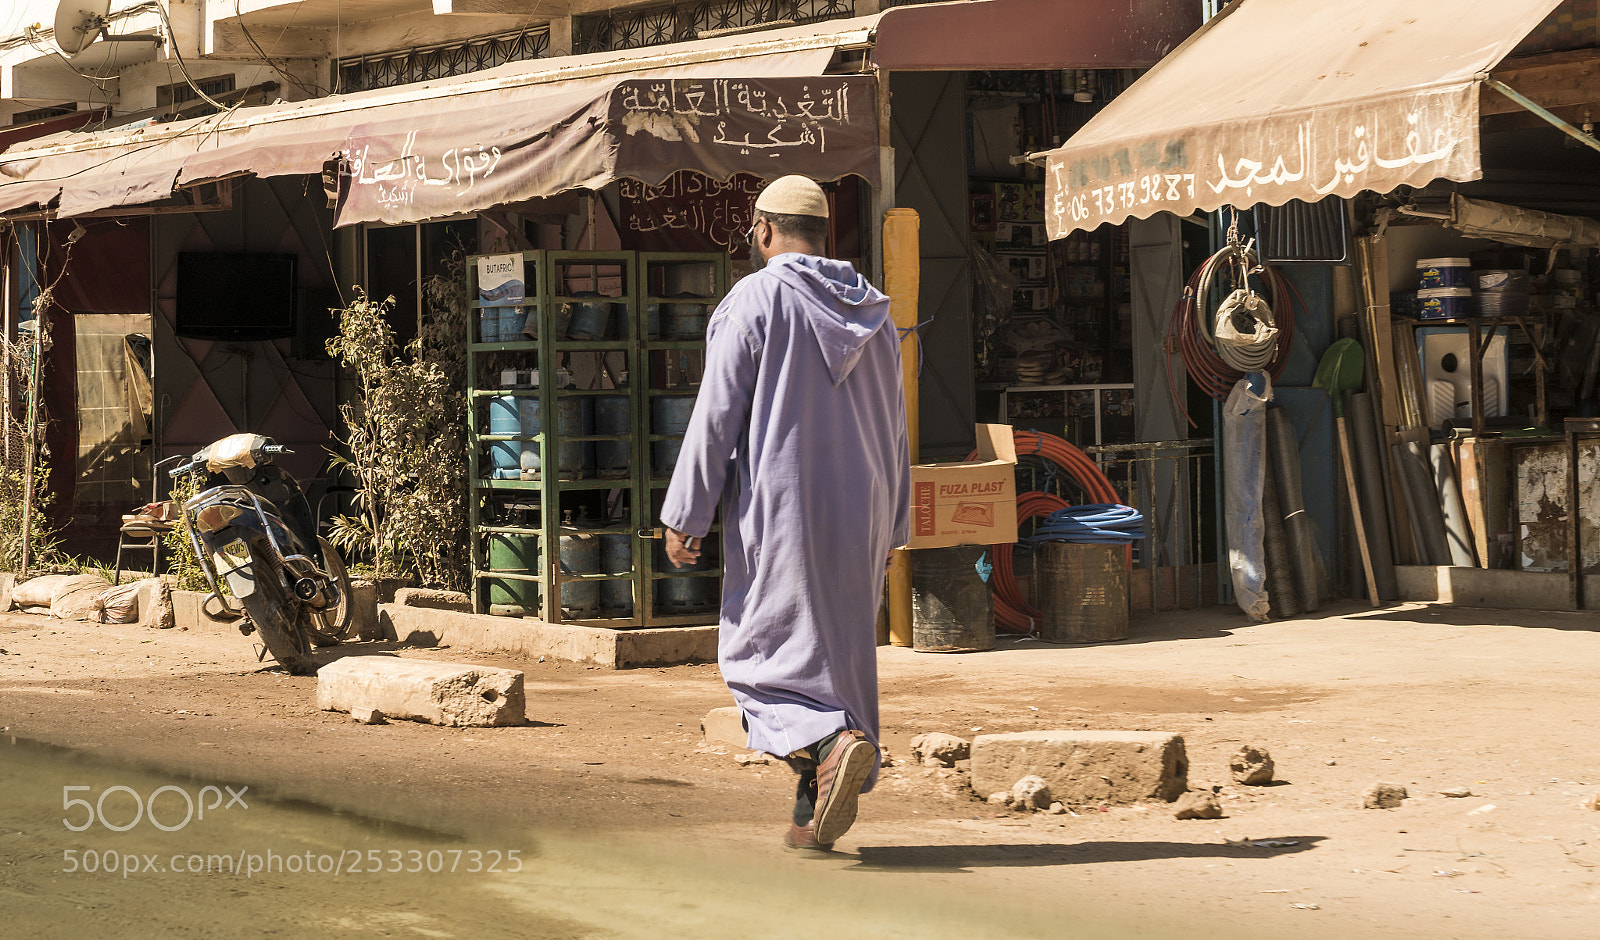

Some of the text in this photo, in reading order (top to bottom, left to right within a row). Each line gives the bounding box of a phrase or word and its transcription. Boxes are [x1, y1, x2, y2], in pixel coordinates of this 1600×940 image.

[1206, 119, 1310, 197] المجد
[486, 263, 513, 274] BUTAFRIC
[939, 481, 1004, 496] FUZA PLAST
[920, 485, 931, 534] TALOCHE
